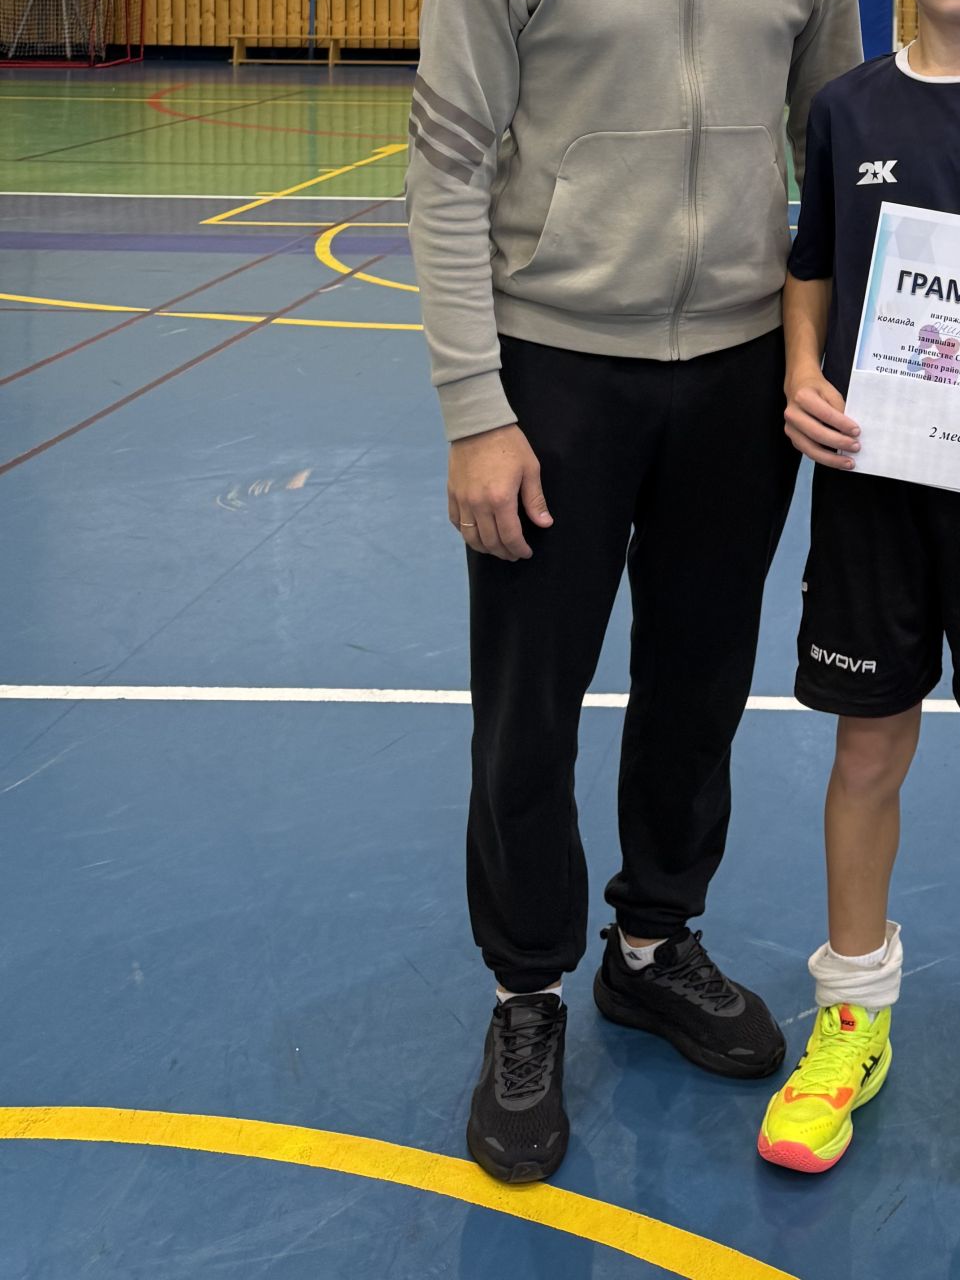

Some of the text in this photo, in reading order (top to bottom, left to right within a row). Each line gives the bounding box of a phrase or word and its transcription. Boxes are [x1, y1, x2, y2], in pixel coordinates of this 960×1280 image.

[856, 159, 898, 185] 2K
[877, 314, 915, 328] команда
[918, 335, 956, 348] занявшая
[872, 352, 939, 370] муниципального
[907, 344, 954, 361] Первенстве
[875, 365, 898, 376] среди
[899, 369, 932, 381] юношей
[934, 375, 952, 385] 2013
[928, 426, 938, 438] 2
[810, 643, 877, 674] GIVOVA
